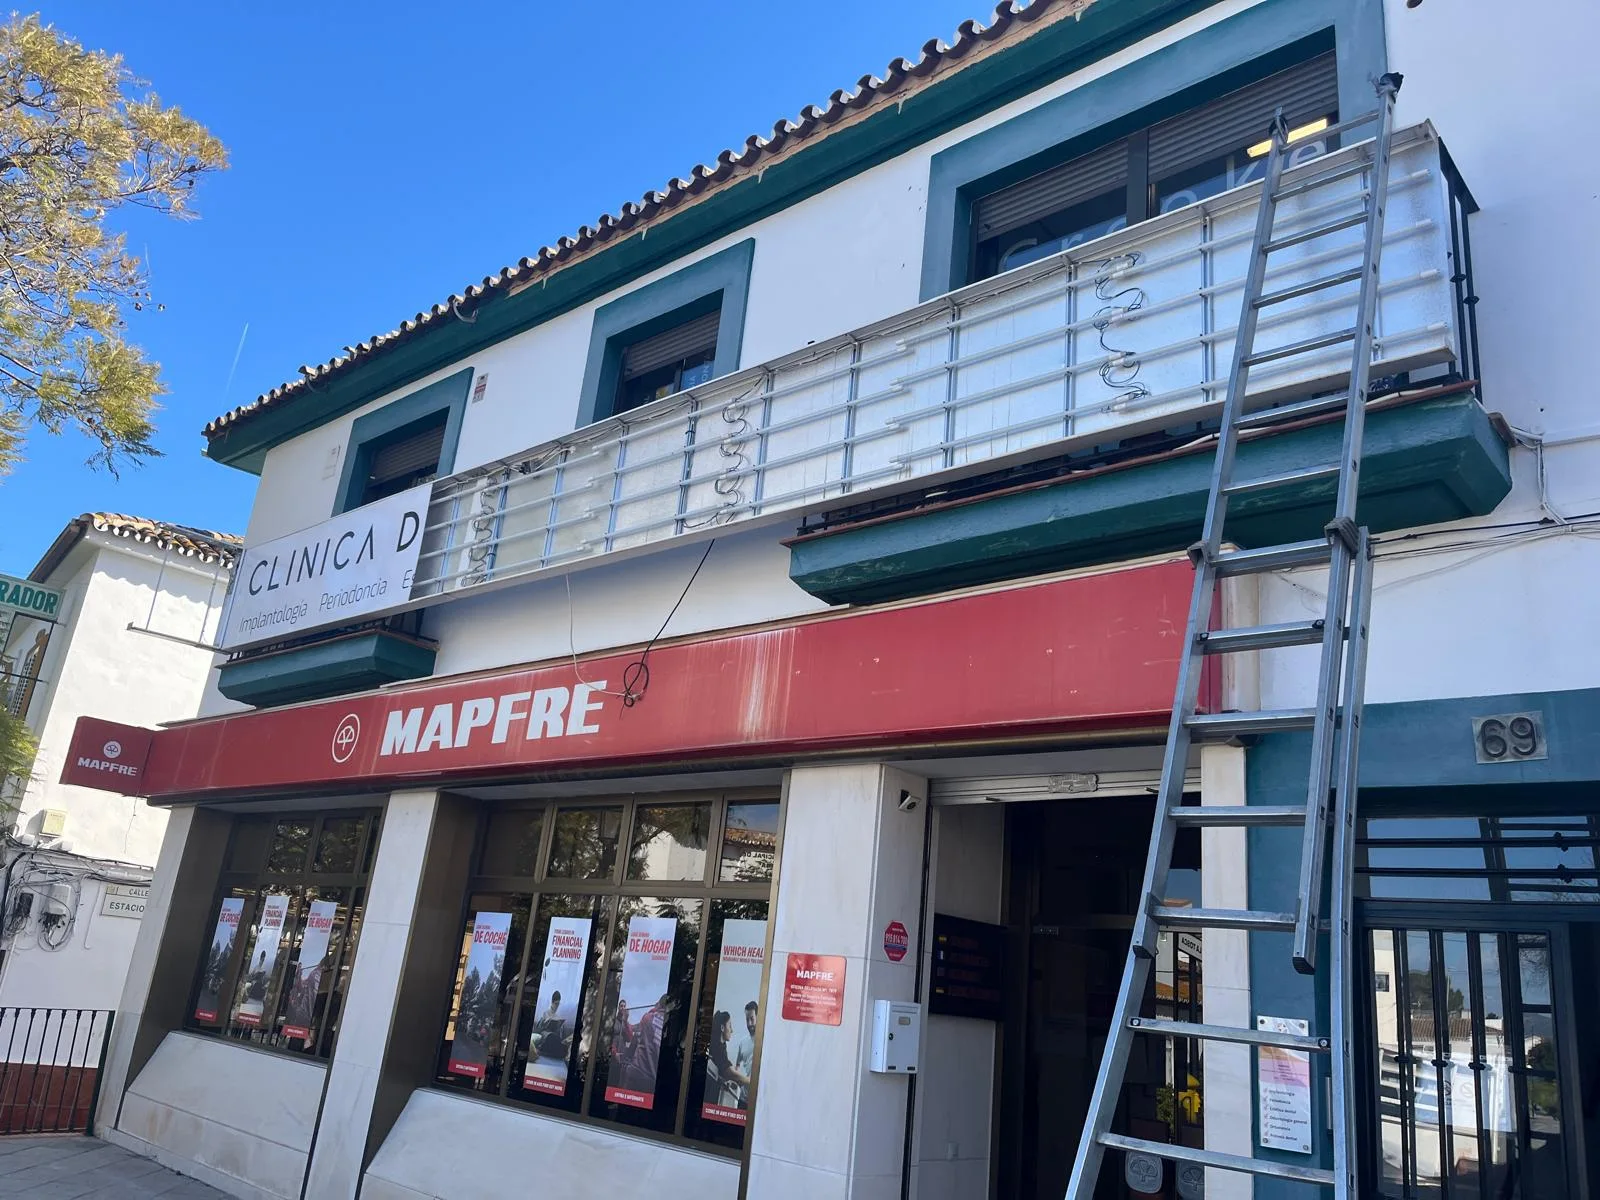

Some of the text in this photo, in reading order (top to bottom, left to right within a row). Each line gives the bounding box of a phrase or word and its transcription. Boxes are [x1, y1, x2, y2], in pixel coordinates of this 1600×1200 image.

[248, 511, 421, 597] CLINICA D
[239, 600, 308, 633] Implantología
[319, 577, 388, 612] Periodoncia
[379, 679, 608, 756] MAPFRE
[1480, 717, 1537, 758] 69
[77, 757, 138, 777] MAPFRE
[129, 888, 149, 897] CALLE
[110, 902, 145, 912] ESTACIO
[474, 931, 507, 945] DE COCHE
[551, 936, 583, 949] FINANCIAL
[552, 947, 582, 960] PLANNING
[629, 939, 672, 954] DE HOGAR
[723, 945, 764, 958] WHICH HEAL
[796, 970, 834, 982] MAPFRE
